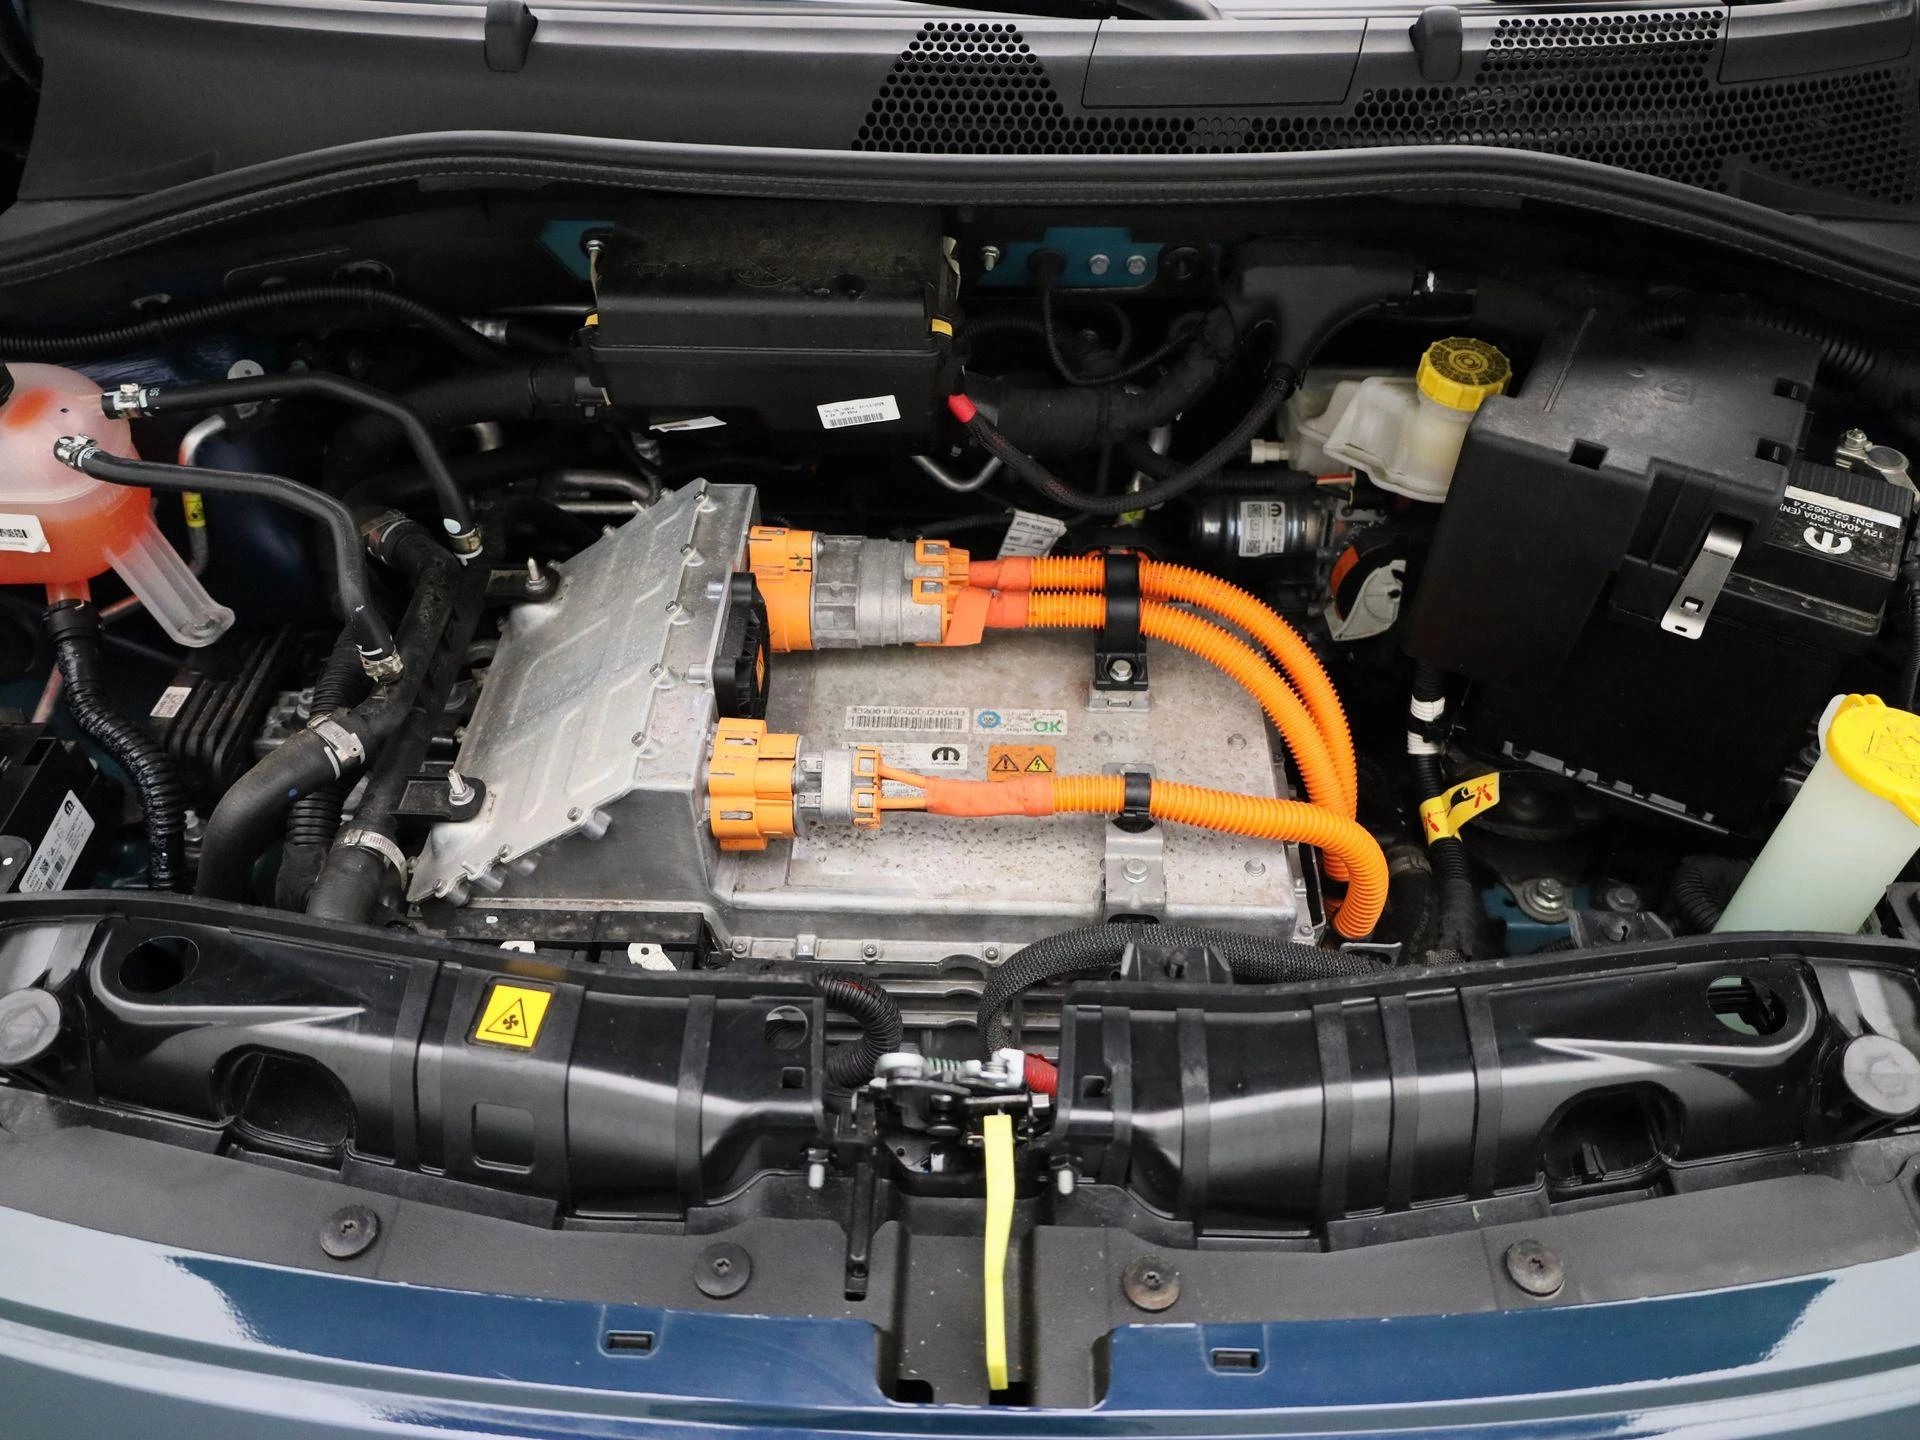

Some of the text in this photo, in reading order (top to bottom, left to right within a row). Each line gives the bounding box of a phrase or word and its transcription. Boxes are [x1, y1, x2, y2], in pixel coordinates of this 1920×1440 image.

[1780, 503, 1884, 539] 12V 40Ah 360A (EN)
[1793, 500, 1874, 527] PN: 52206274
[1034, 720, 1063, 733] OK
